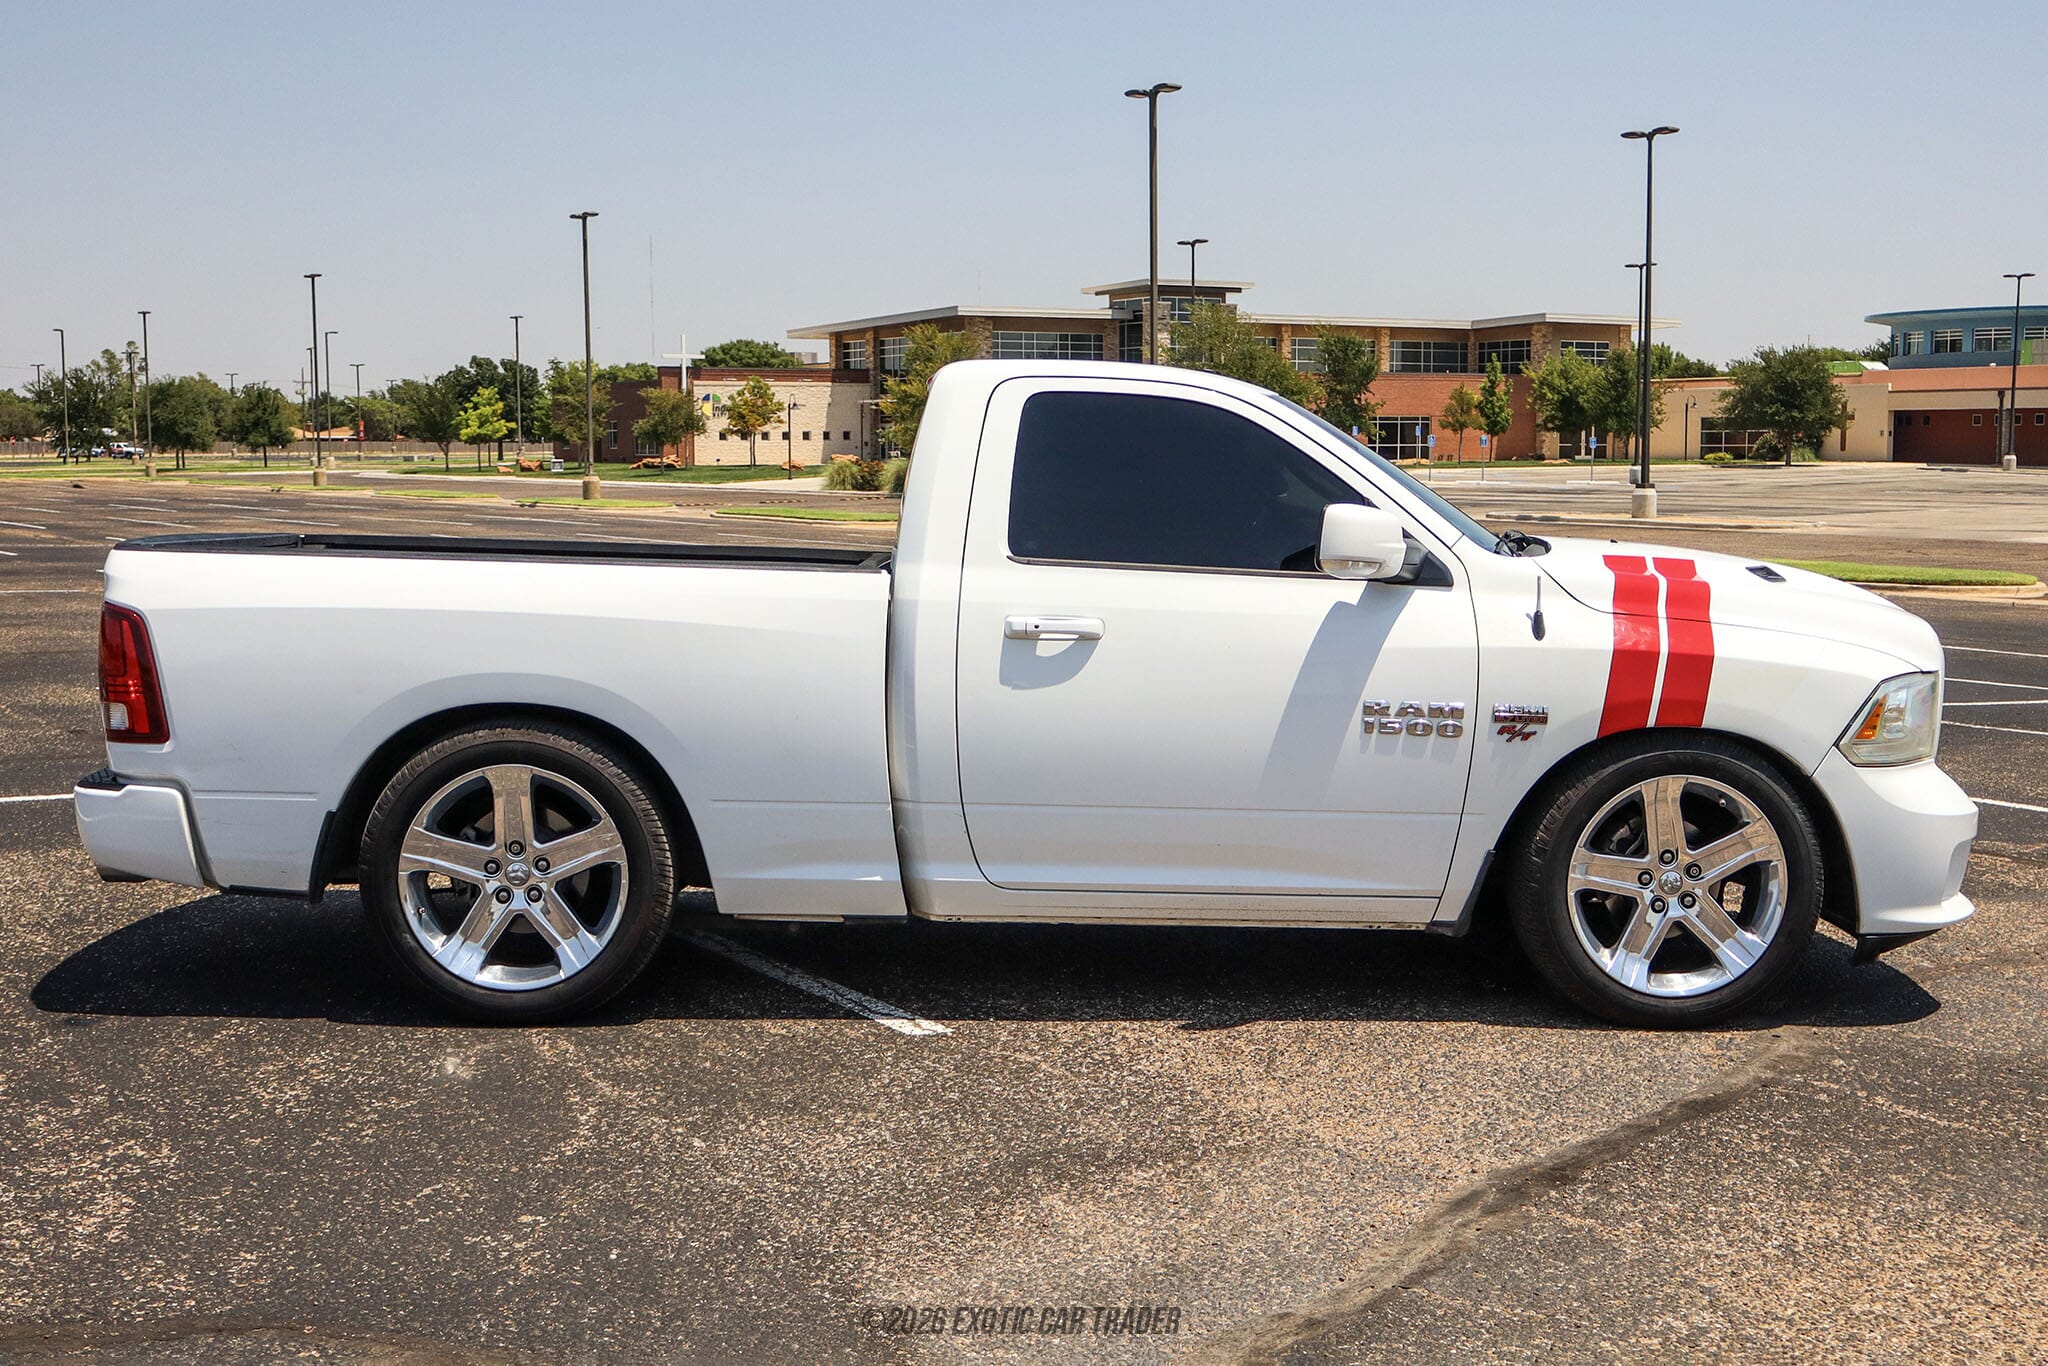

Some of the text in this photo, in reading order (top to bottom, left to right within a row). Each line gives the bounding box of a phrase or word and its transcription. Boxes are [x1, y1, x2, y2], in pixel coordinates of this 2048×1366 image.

[1363, 700, 1464, 719] RAM
[1363, 717, 1463, 738] 1500
[1497, 722, 1537, 742] R/T
